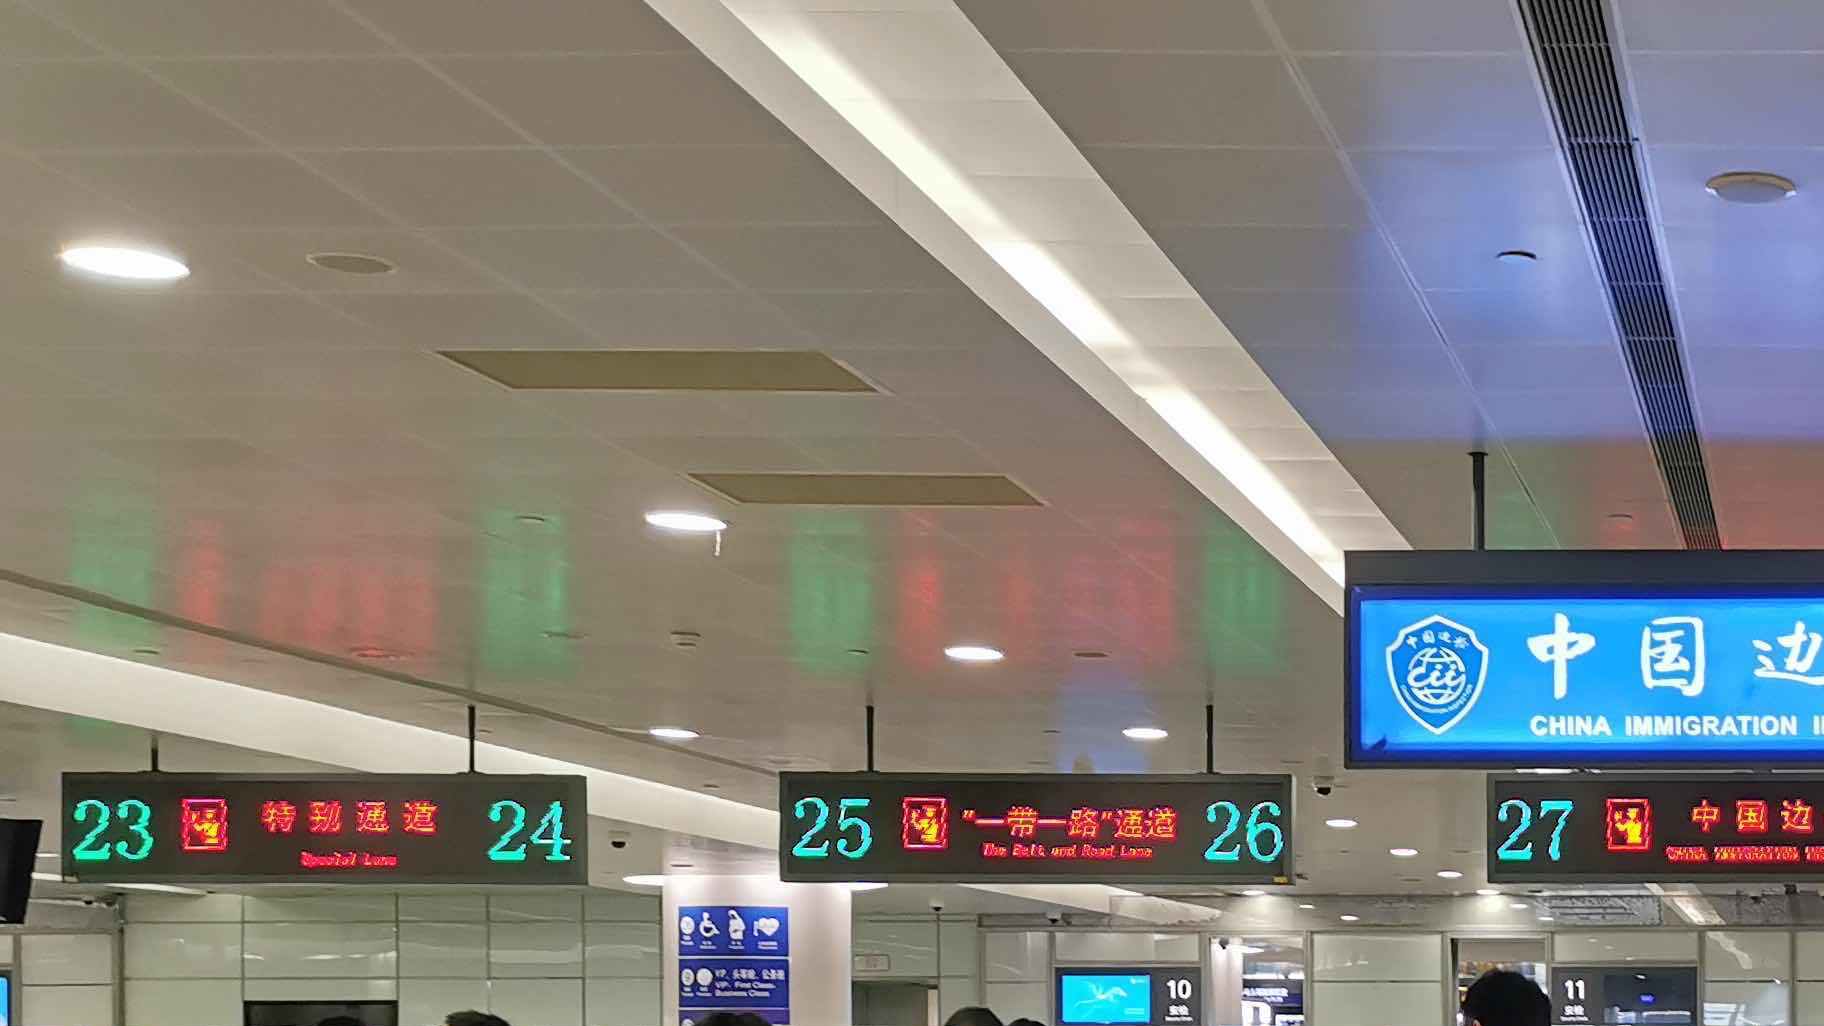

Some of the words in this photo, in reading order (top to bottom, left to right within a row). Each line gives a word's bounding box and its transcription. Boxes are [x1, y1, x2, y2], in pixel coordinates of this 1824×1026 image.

[1529, 715, 1611, 737] CHINA
[1625, 715, 1797, 737] IMMIGRATION
[73, 800, 154, 861] 23
[261, 801, 440, 833] 特别通道
[488, 800, 572, 862] 24
[792, 798, 873, 859] 25
[1205, 800, 1286, 862] 26
[1497, 800, 1574, 861] 27
[1166, 980, 1192, 999] 10
[1564, 979, 1585, 1000] 11
